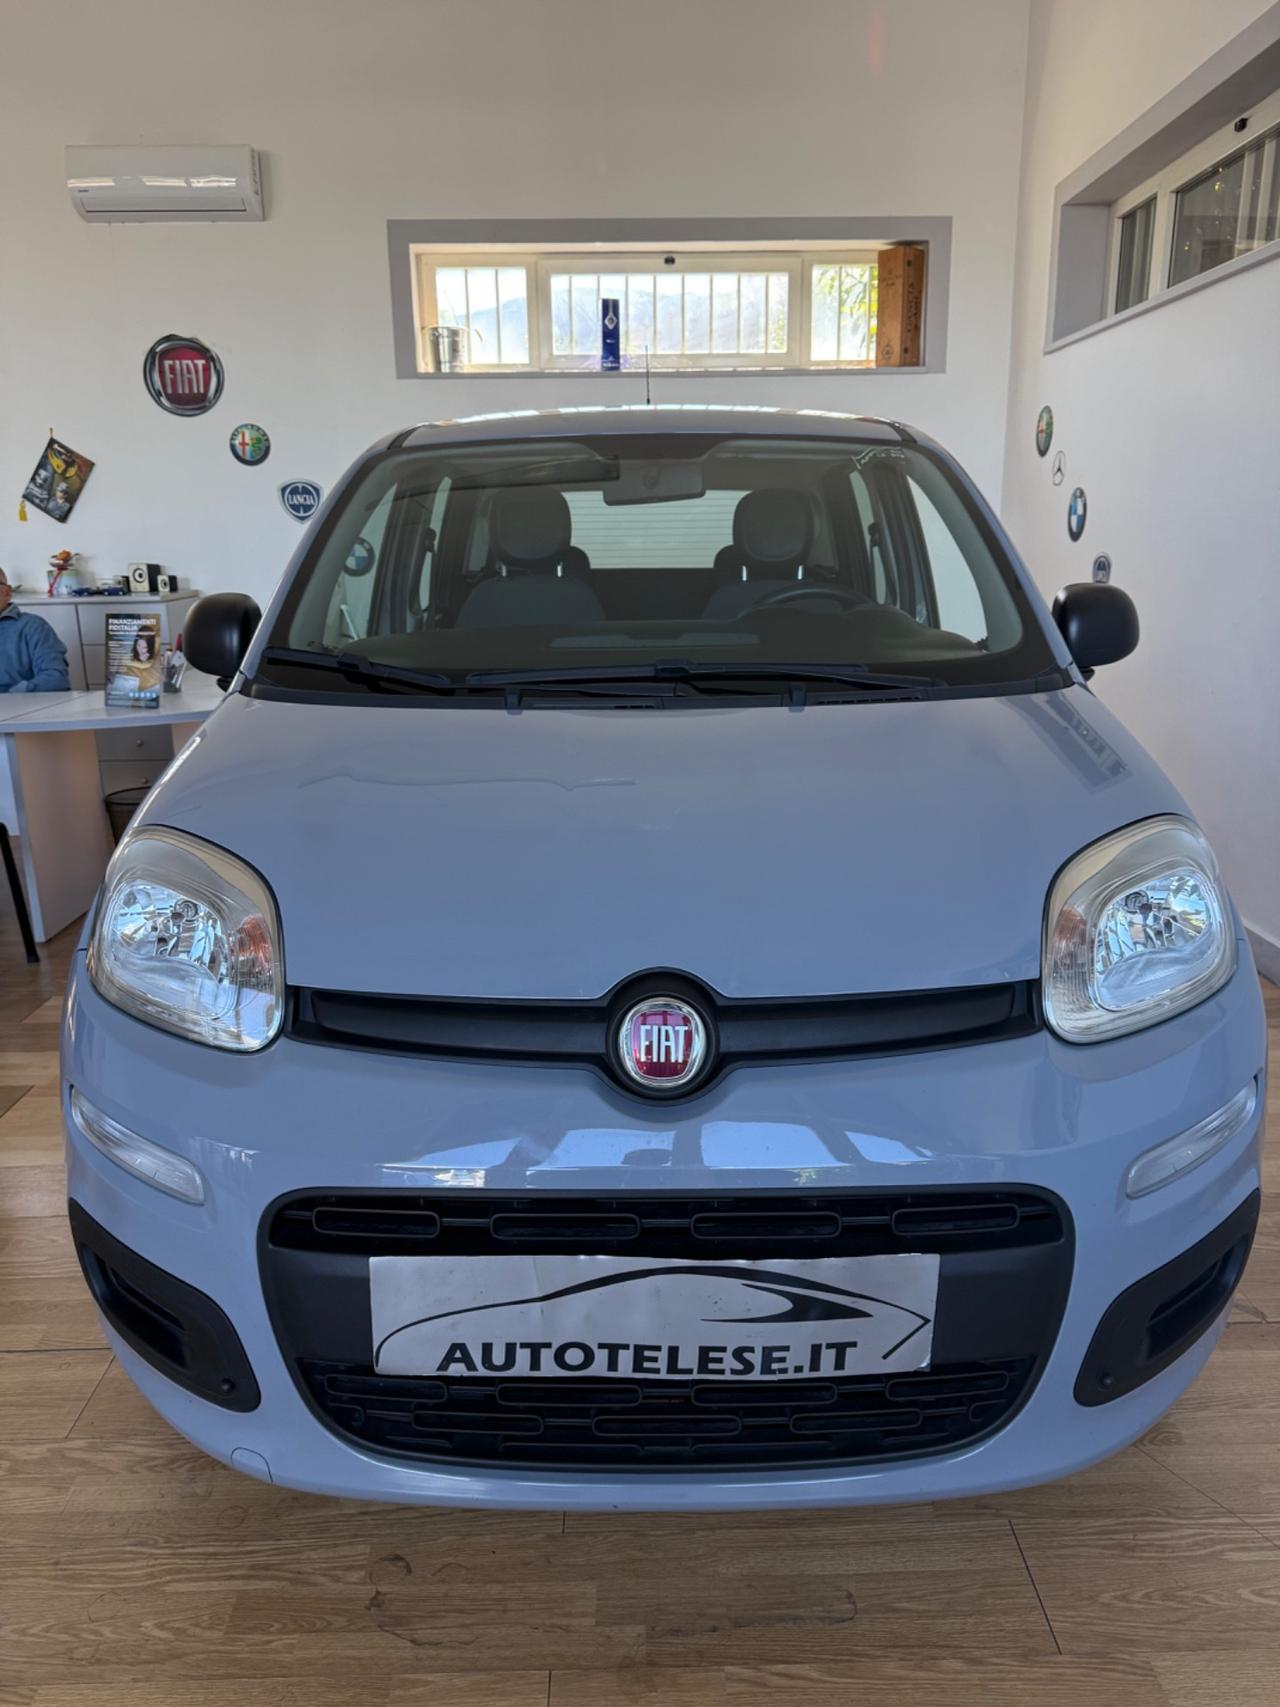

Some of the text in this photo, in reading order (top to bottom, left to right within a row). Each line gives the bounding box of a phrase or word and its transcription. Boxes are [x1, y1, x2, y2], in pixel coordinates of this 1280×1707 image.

[163, 359, 206, 394] FIAT
[288, 494, 315, 505] LANCIA
[640, 1025, 689, 1063] FIAT
[436, 1341, 858, 1376] AUTOTELESE.IT
